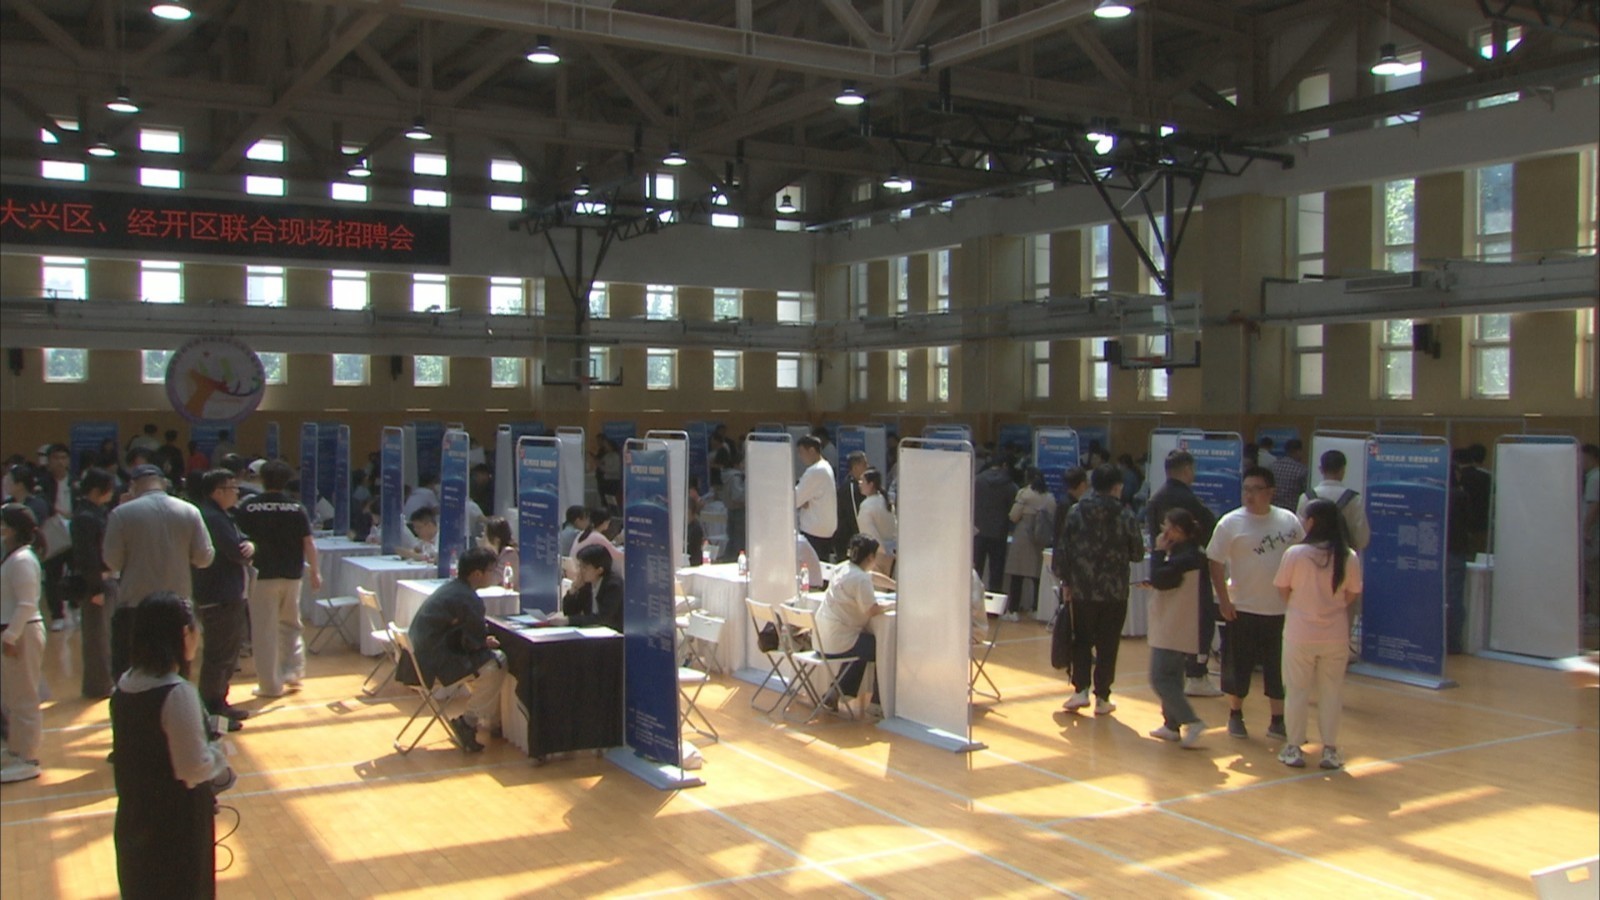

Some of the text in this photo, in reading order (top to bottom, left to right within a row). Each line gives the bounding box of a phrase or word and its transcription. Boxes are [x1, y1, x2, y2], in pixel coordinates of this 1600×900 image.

[1, 198, 415, 251] 大兴区、经开区联合现场招聘会
